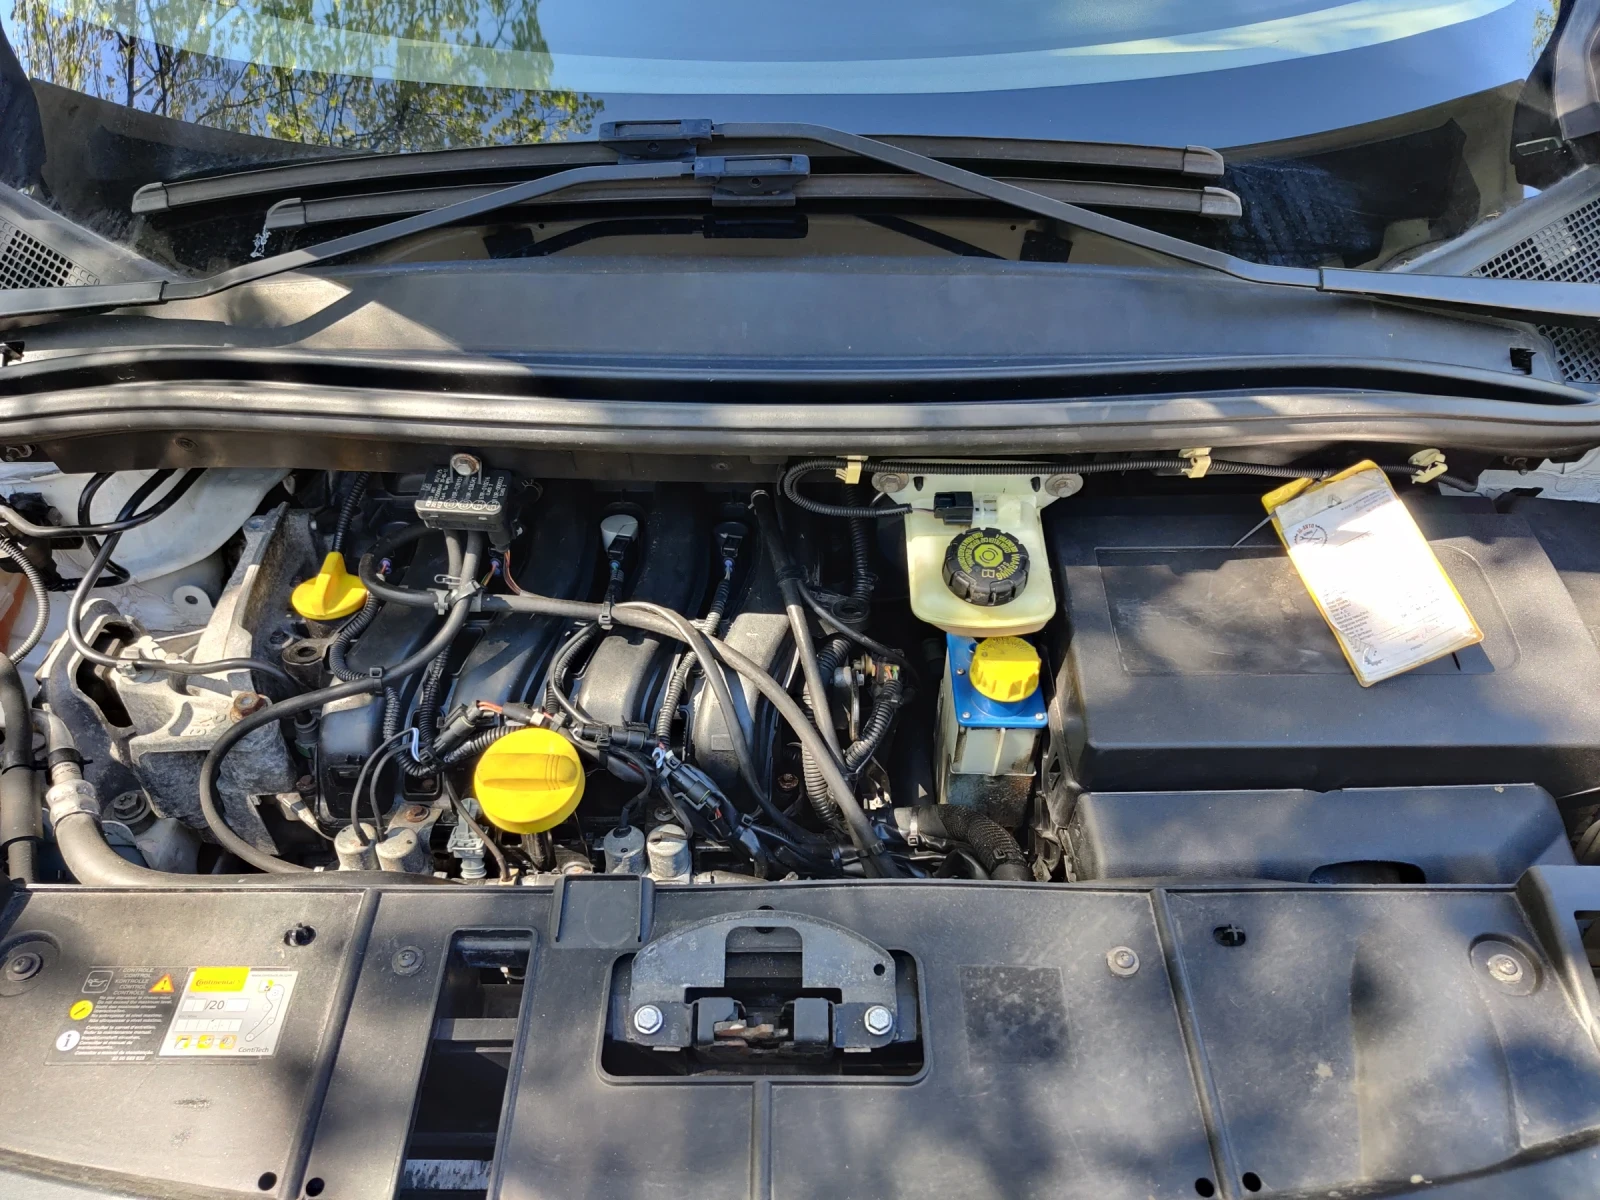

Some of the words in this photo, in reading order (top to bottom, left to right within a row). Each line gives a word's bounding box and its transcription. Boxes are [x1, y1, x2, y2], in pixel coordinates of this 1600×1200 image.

[996, 554, 1020, 580] WARNING
[997, 562, 1009, 571] SEE
[204, 1000, 224, 1010] /20
